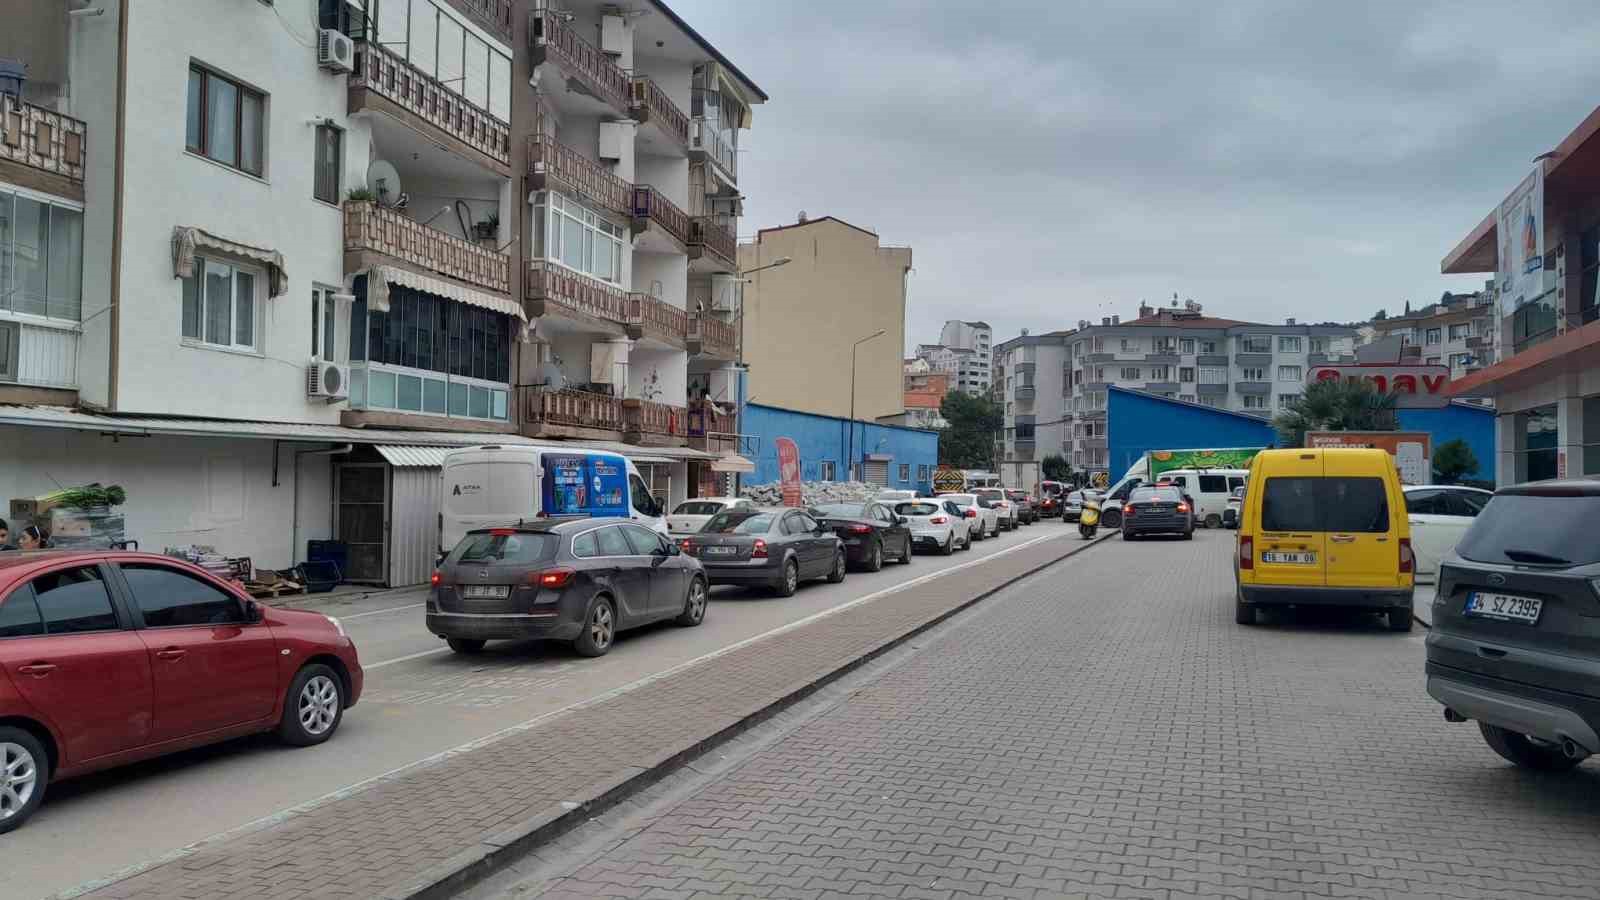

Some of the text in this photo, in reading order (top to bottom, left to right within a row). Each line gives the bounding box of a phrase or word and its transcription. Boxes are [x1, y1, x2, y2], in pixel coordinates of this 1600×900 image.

[1472, 594, 1539, 618] 34 SZ 2395
